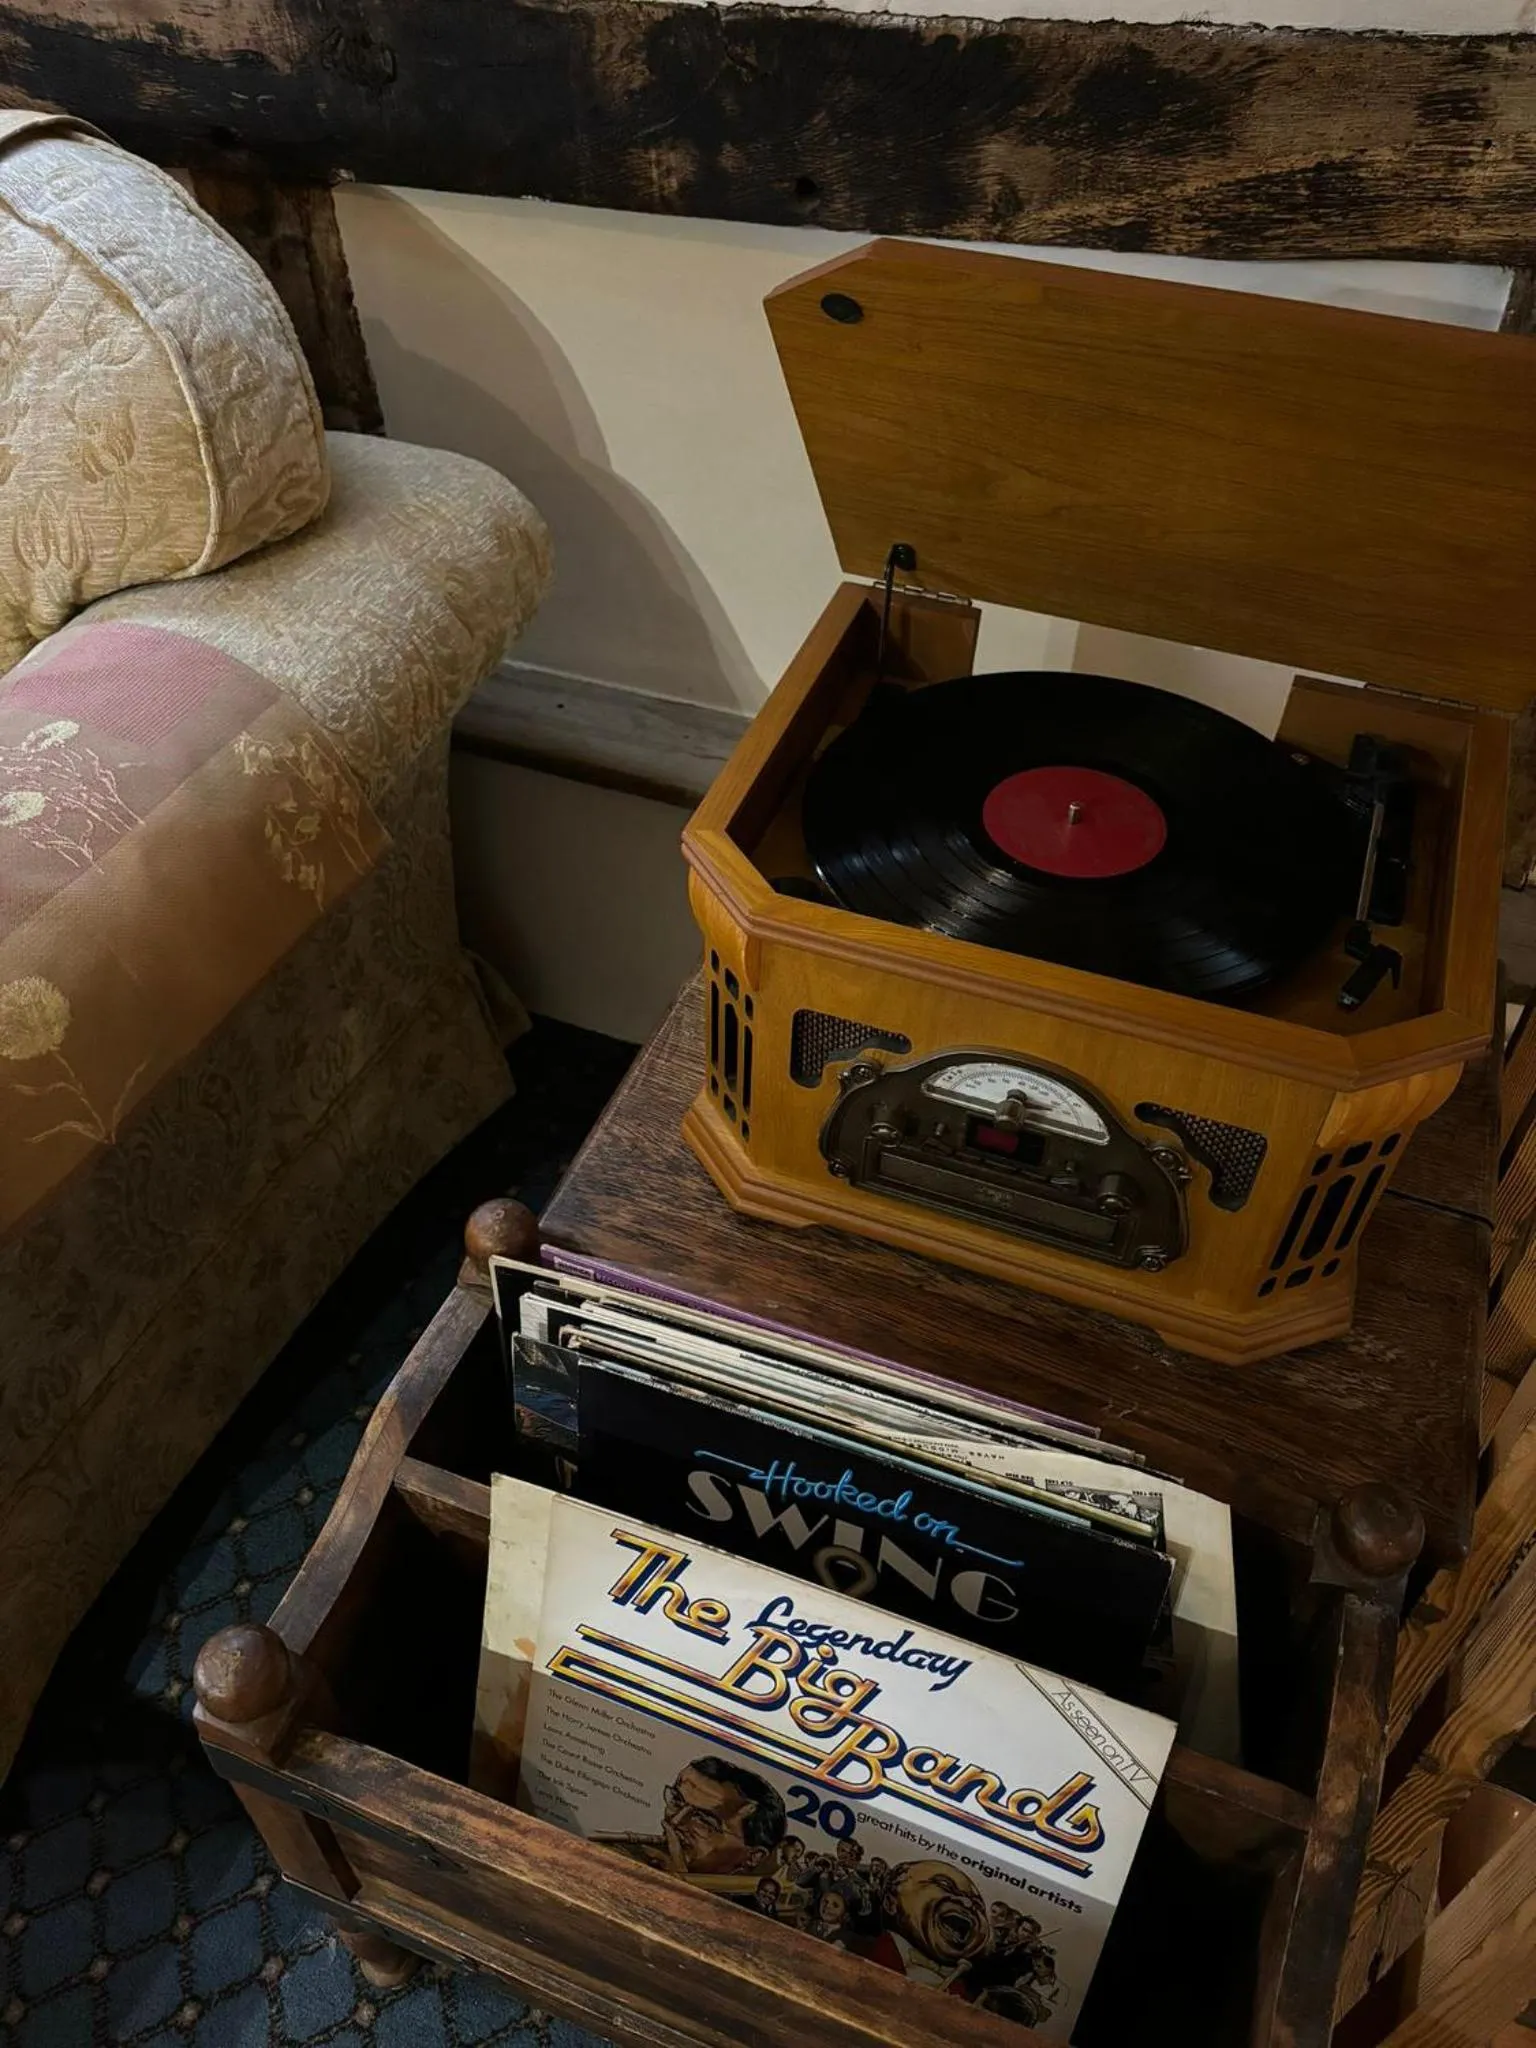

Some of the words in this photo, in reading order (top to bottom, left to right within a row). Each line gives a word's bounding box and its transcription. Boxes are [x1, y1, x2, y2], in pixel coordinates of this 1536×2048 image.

[750, 1460, 908, 1520] Hooked
[608, 1528, 730, 1646] The
[685, 1470, 1019, 1622] SWING
[719, 1627, 882, 1738] Big
[743, 1596, 973, 1692] Legendary
[1051, 1690, 1075, 1712] As
[1070, 1709, 1106, 1746] seen
[1103, 1744, 1125, 1766] on
[1121, 1758, 1150, 1782] TV
[785, 1784, 856, 1839] 20
[816, 1717, 1106, 1853] Bands
[856, 1811, 895, 1836] great
[895, 1822, 917, 1843] hits
[917, 1833, 936, 1851] by
[936, 1842, 958, 1861] the
[960, 1854, 1027, 1890] original
[1027, 1883, 1083, 1915] artists
